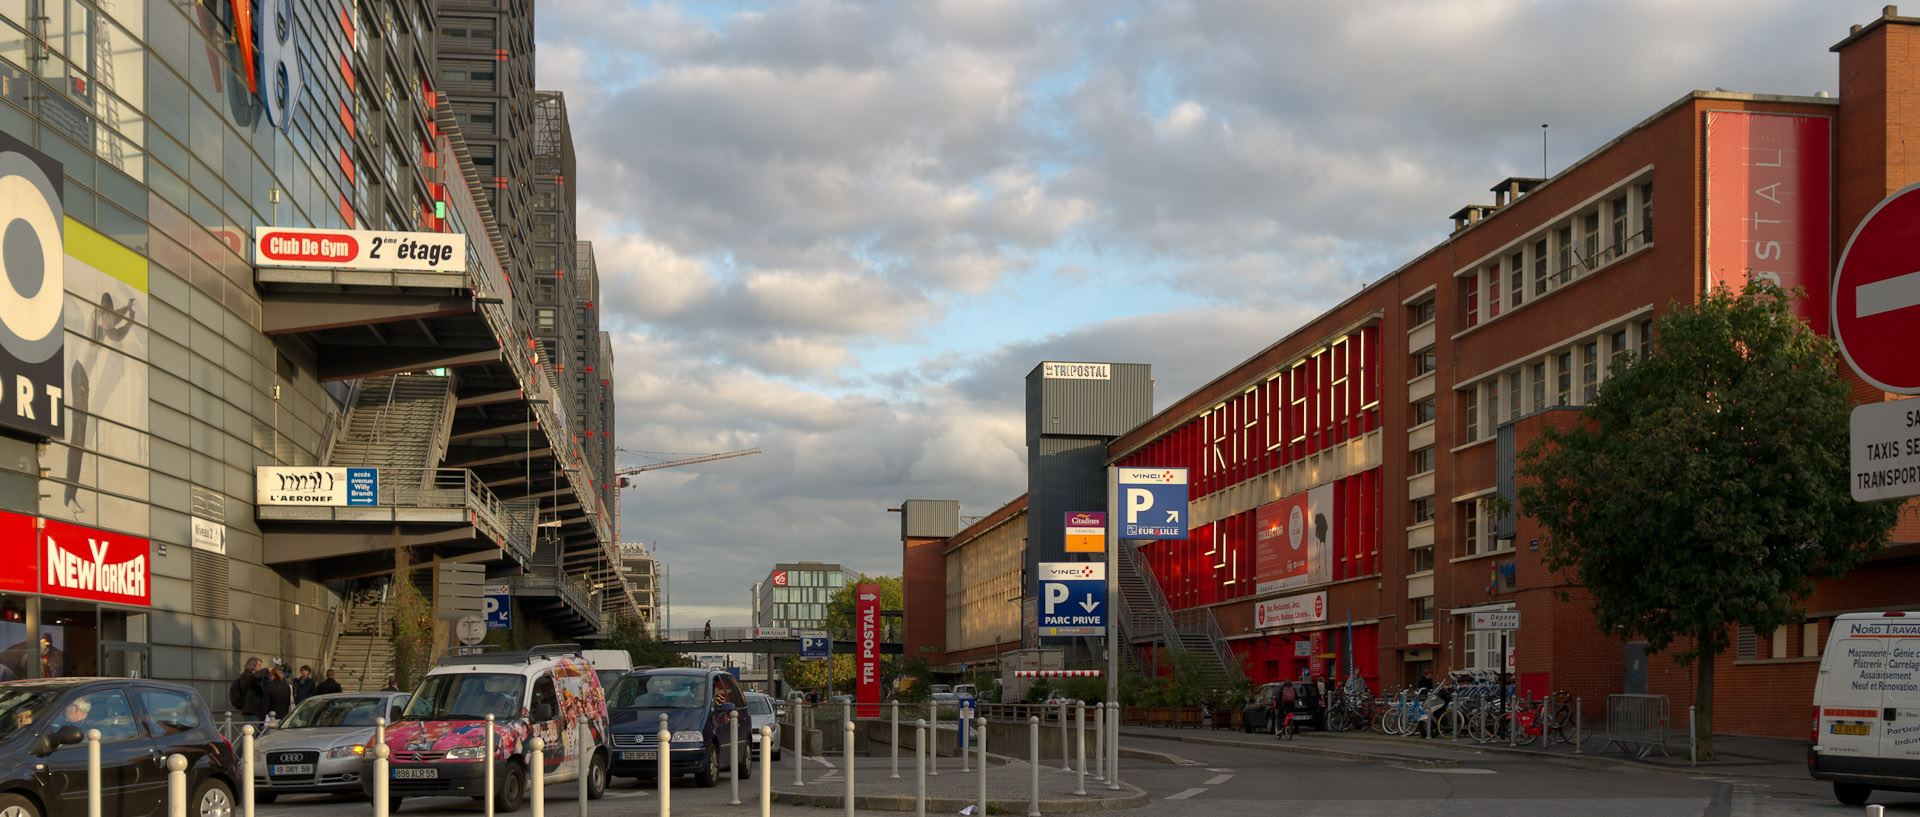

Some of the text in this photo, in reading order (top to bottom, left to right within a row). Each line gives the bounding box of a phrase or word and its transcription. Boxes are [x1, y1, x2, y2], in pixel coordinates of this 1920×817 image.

[270, 236, 299, 255] Club
[301, 238, 319, 255] De
[321, 239, 348, 258] Gym
[397, 238, 453, 266] étage
[0, 374, 62, 427] RT
[1867, 438, 1920, 461] TAXIS SE
[270, 495, 333, 503] L'AERONEF
[1127, 488, 1154, 524] P
[1071, 516, 1100, 525] Citadines
[1258, 525, 1284, 541] COLLECTOR
[1045, 582, 1069, 614] P
[1045, 616, 1101, 624] PARC PRIVE
[803, 639, 813, 652] P
[863, 606, 874, 685] TRI POSTAL
[1848, 648, 1887, 658] Maçonnerie
[1893, 648, 1914, 658] Génie
[1888, 659, 1920, 671] Carrelag
[1860, 670, 1912, 680] Assainissement
[1851, 681, 1869, 690] Neuf
[1878, 681, 1918, 691] Rénovation
[396, 769, 435, 778] 898 ALR 59
